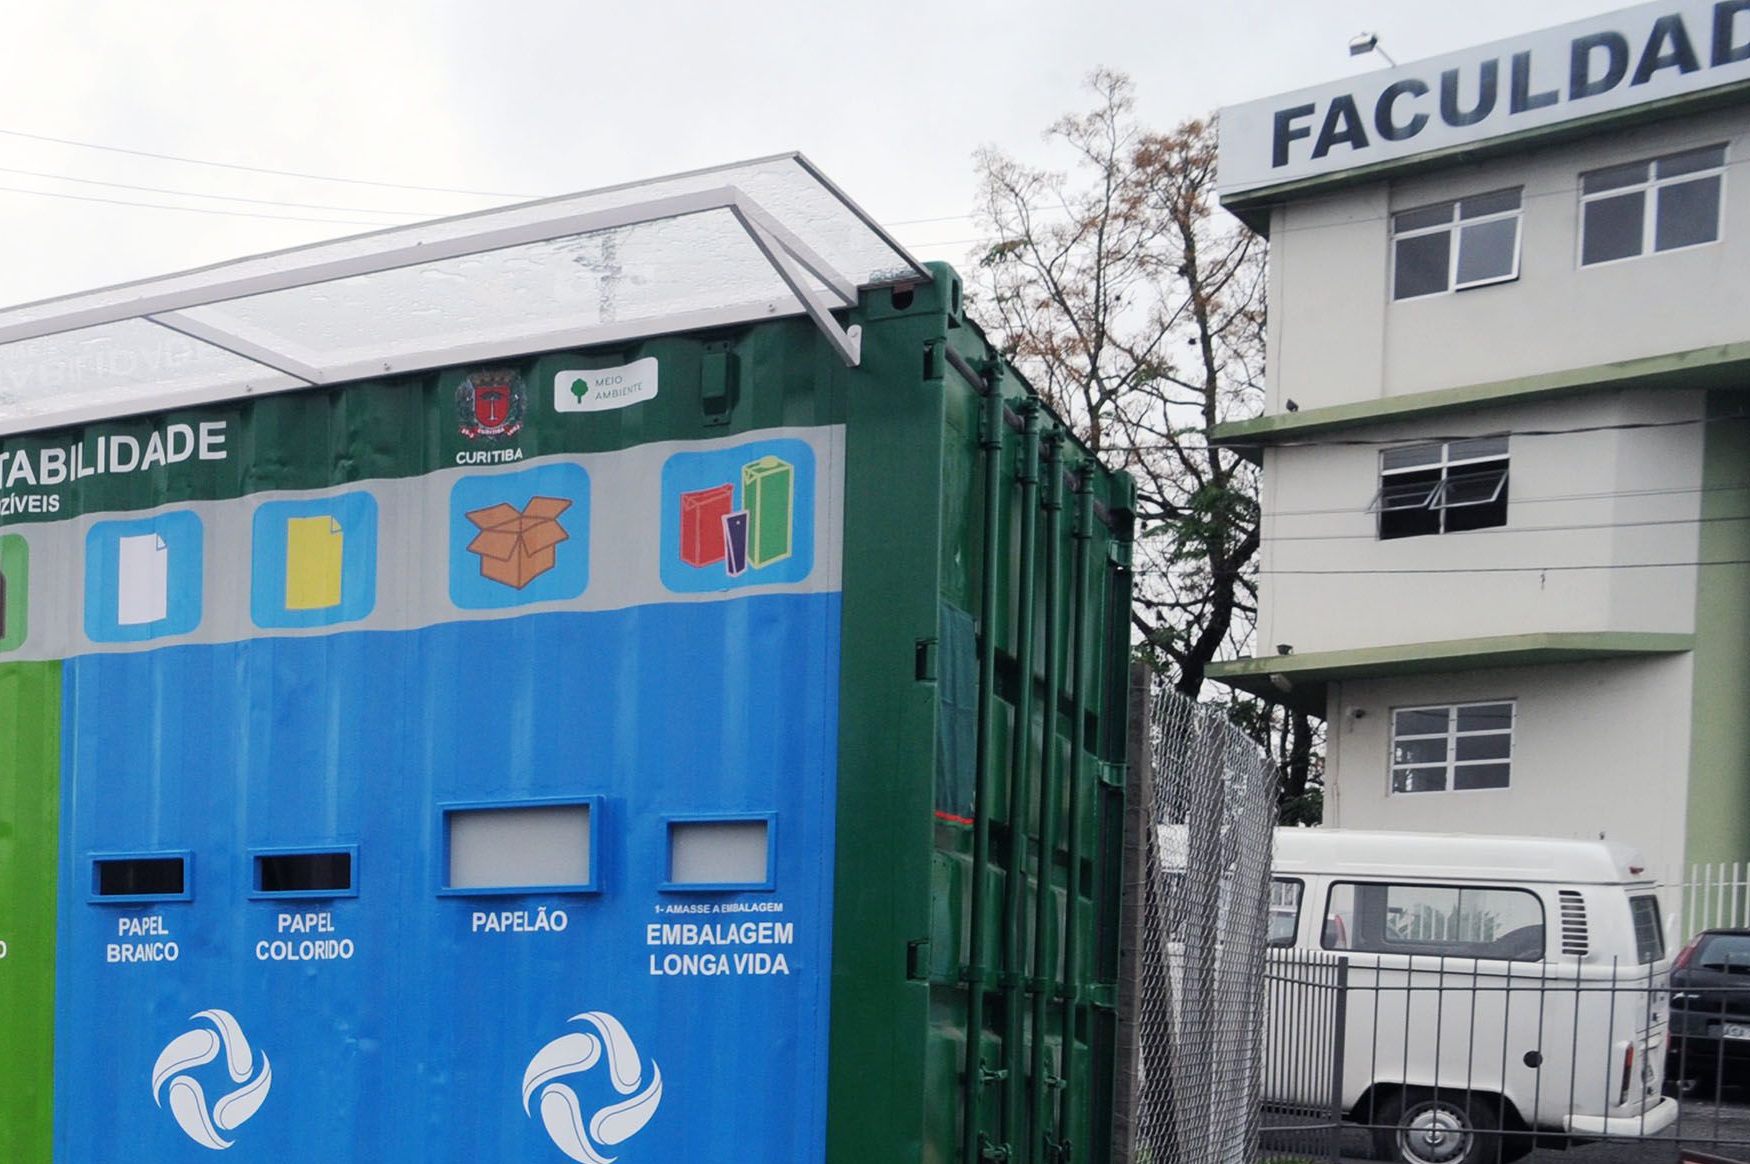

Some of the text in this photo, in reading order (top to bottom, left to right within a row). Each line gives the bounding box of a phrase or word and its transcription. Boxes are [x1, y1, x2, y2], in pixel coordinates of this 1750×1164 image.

[1272, 0, 1750, 168] FACULDAD
[595, 375, 623, 386] MEIO
[595, 382, 643, 401] AMBIENTE
[456, 447, 523, 464] CURITIBA
[666, 904, 711, 914] AMASSE
[712, 904, 720, 914] A
[721, 902, 784, 914] EMBALAGEM
[118, 916, 169, 936] PAPEL
[278, 912, 335, 933] PAPEL
[472, 906, 568, 933] PAPELÃO
[646, 922, 794, 946] EMBALAGEM
[106, 941, 179, 963] BRANCO
[255, 938, 354, 961] COLORIDO
[649, 952, 789, 976] LONGA VIDA
